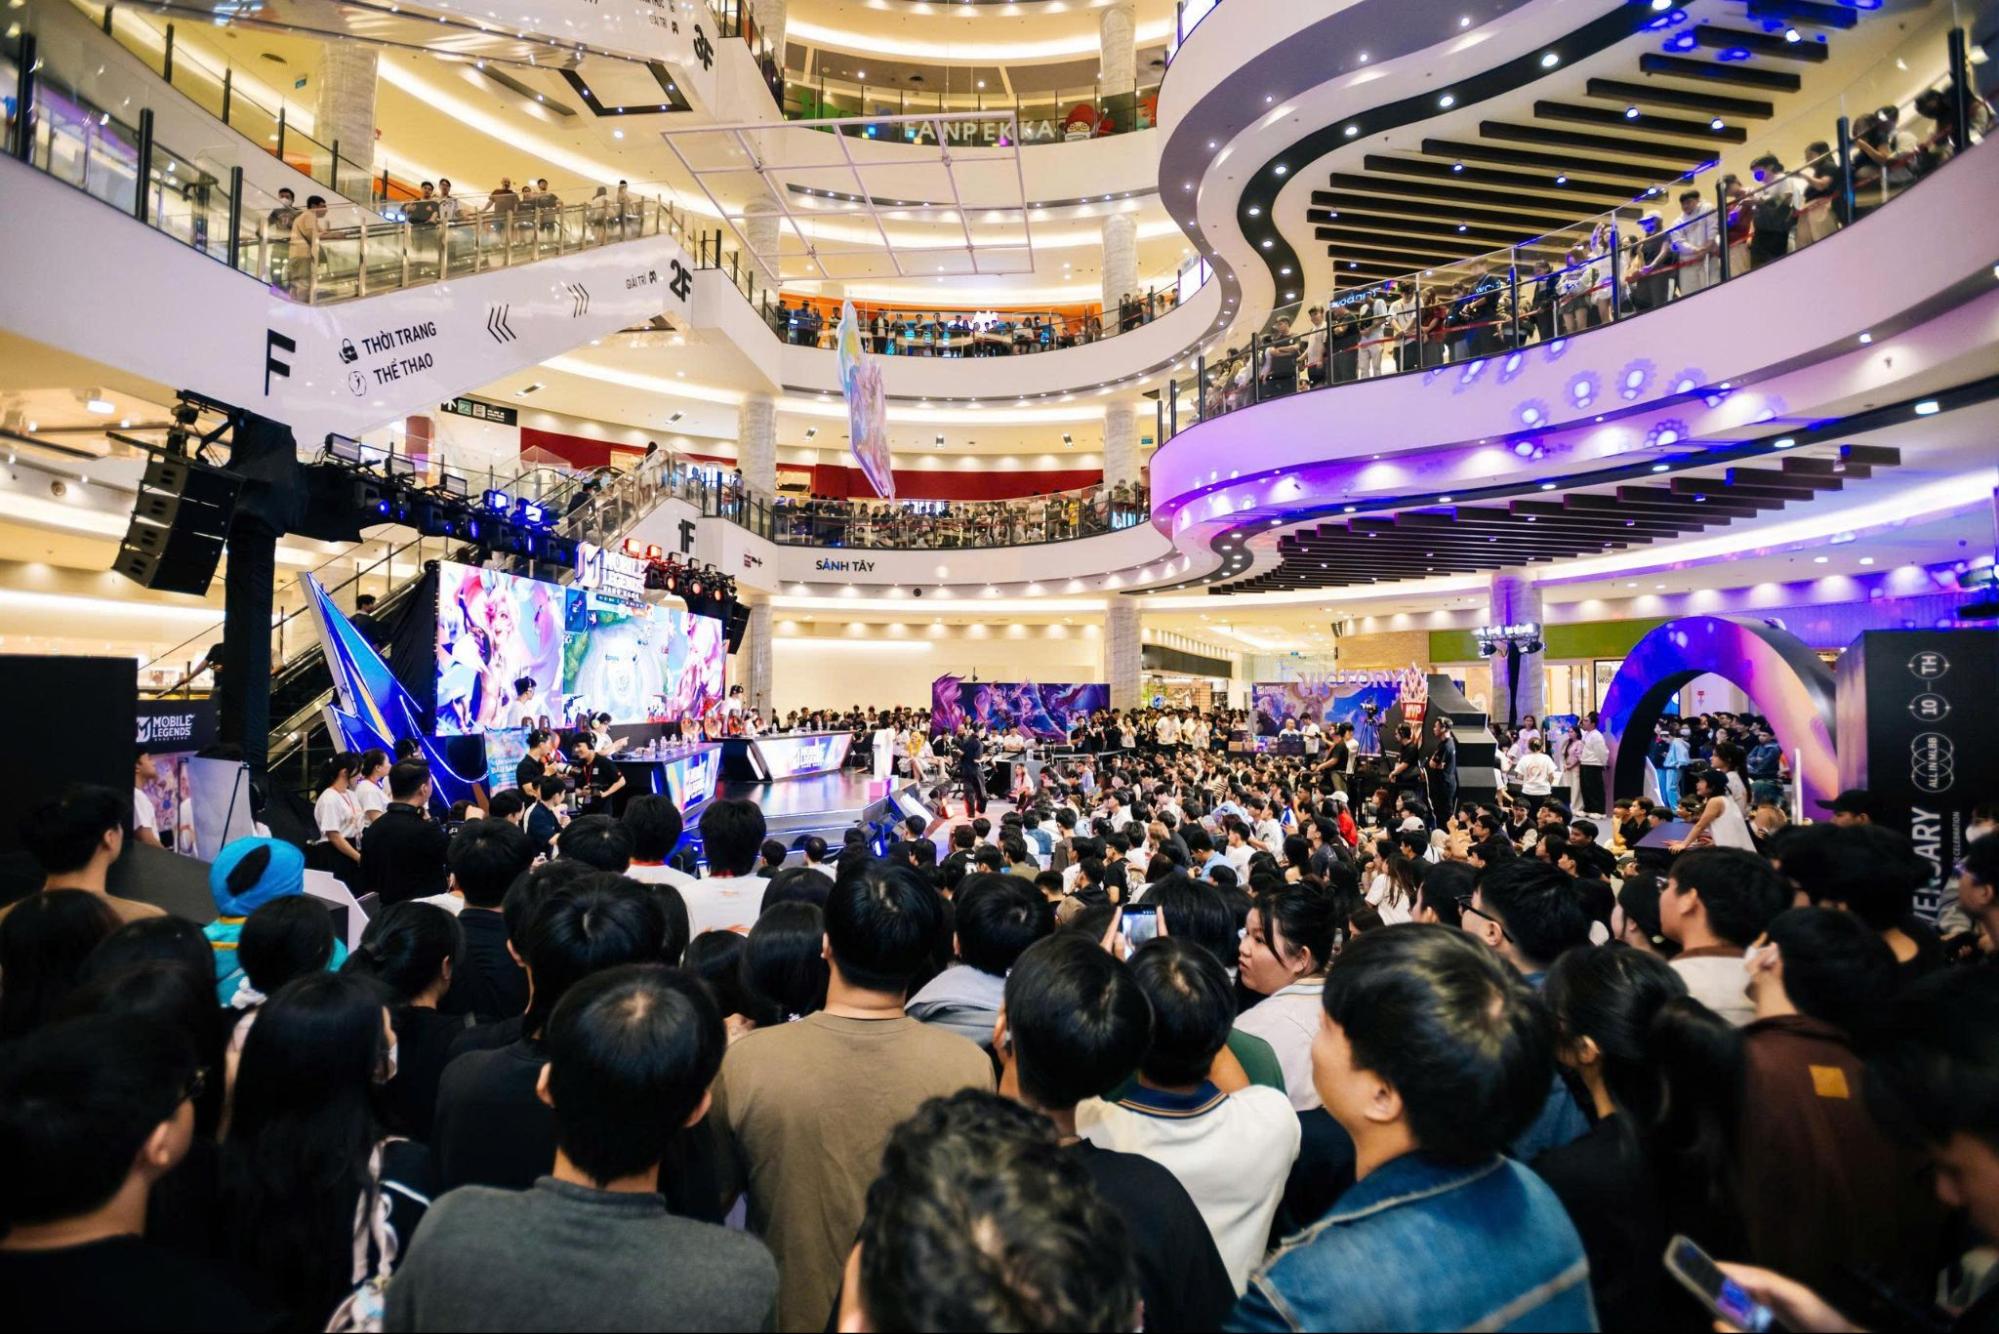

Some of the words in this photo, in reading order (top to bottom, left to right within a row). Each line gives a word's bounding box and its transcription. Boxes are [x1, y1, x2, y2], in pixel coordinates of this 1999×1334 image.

[693, 24, 714, 71] 3F
[669, 258, 692, 302] 2F
[362, 330, 394, 355] THỜI
[396, 321, 437, 347] TRANG
[264, 328, 296, 396] F
[373, 358, 400, 385] THỂ
[400, 353, 433, 376] THAO
[678, 518, 695, 554] 1F
[816, 557, 849, 572] SẢNH
[852, 561, 875, 572] TÂY
[1921, 656, 1937, 675] TH
[1297, 669, 1405, 688] VICTORY
[1921, 699, 1938, 715] 10
[153, 713, 195, 728] MOBILE
[152, 726, 192, 738] LEGENDS
[1927, 737, 1938, 762] MLBB
[1927, 762, 1938, 771] IN
[1927, 772, 1938, 788] ALL
